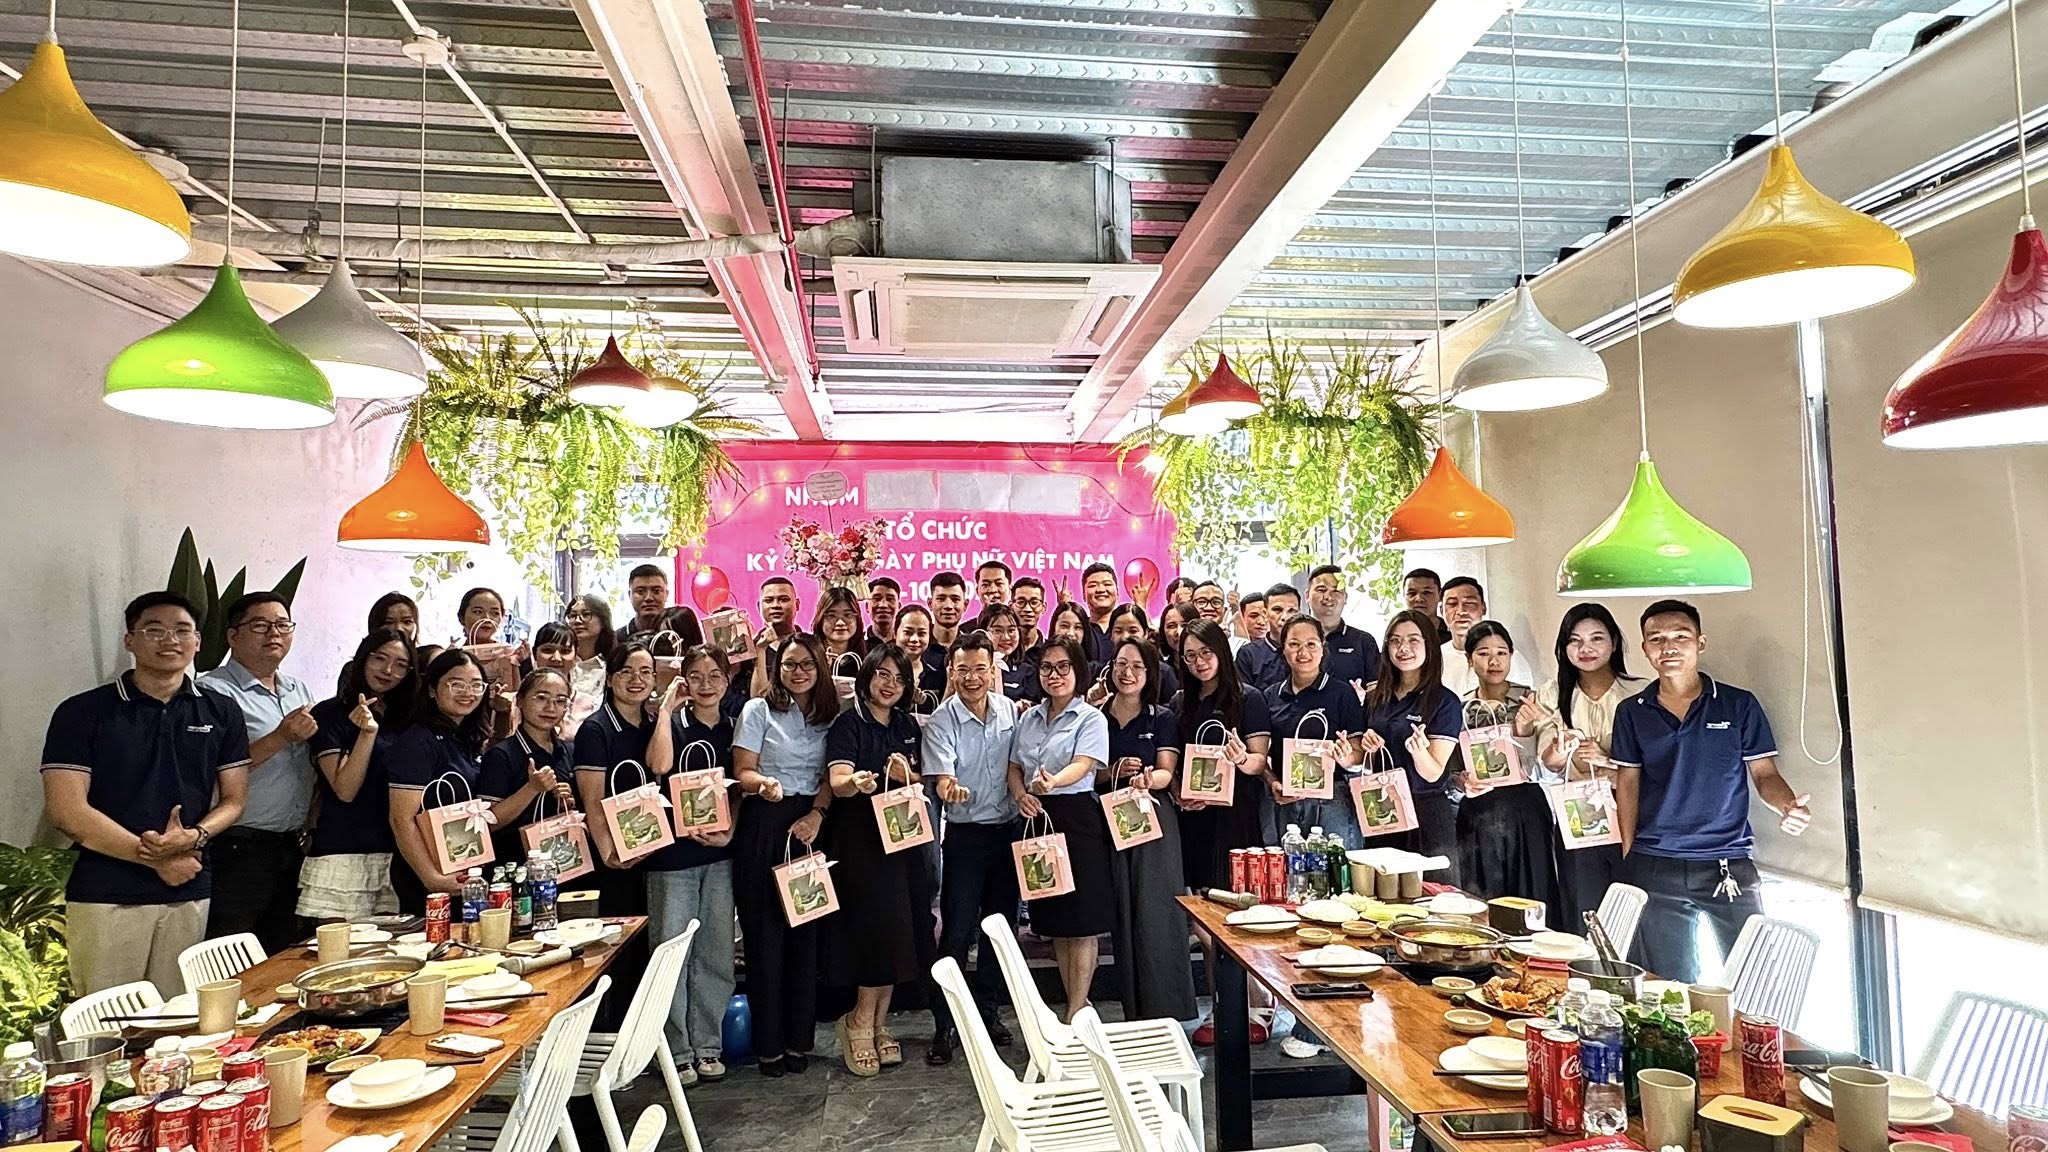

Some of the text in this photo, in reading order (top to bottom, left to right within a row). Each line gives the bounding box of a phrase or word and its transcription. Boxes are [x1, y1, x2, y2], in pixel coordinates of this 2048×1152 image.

[885, 511, 987, 541] TỔ CHỨC
[746, 548, 779, 572] KỶ
[922, 551, 967, 573] PHỤ
[1010, 547, 1057, 574] VIỆT
[1063, 551, 1115, 570] NAM
